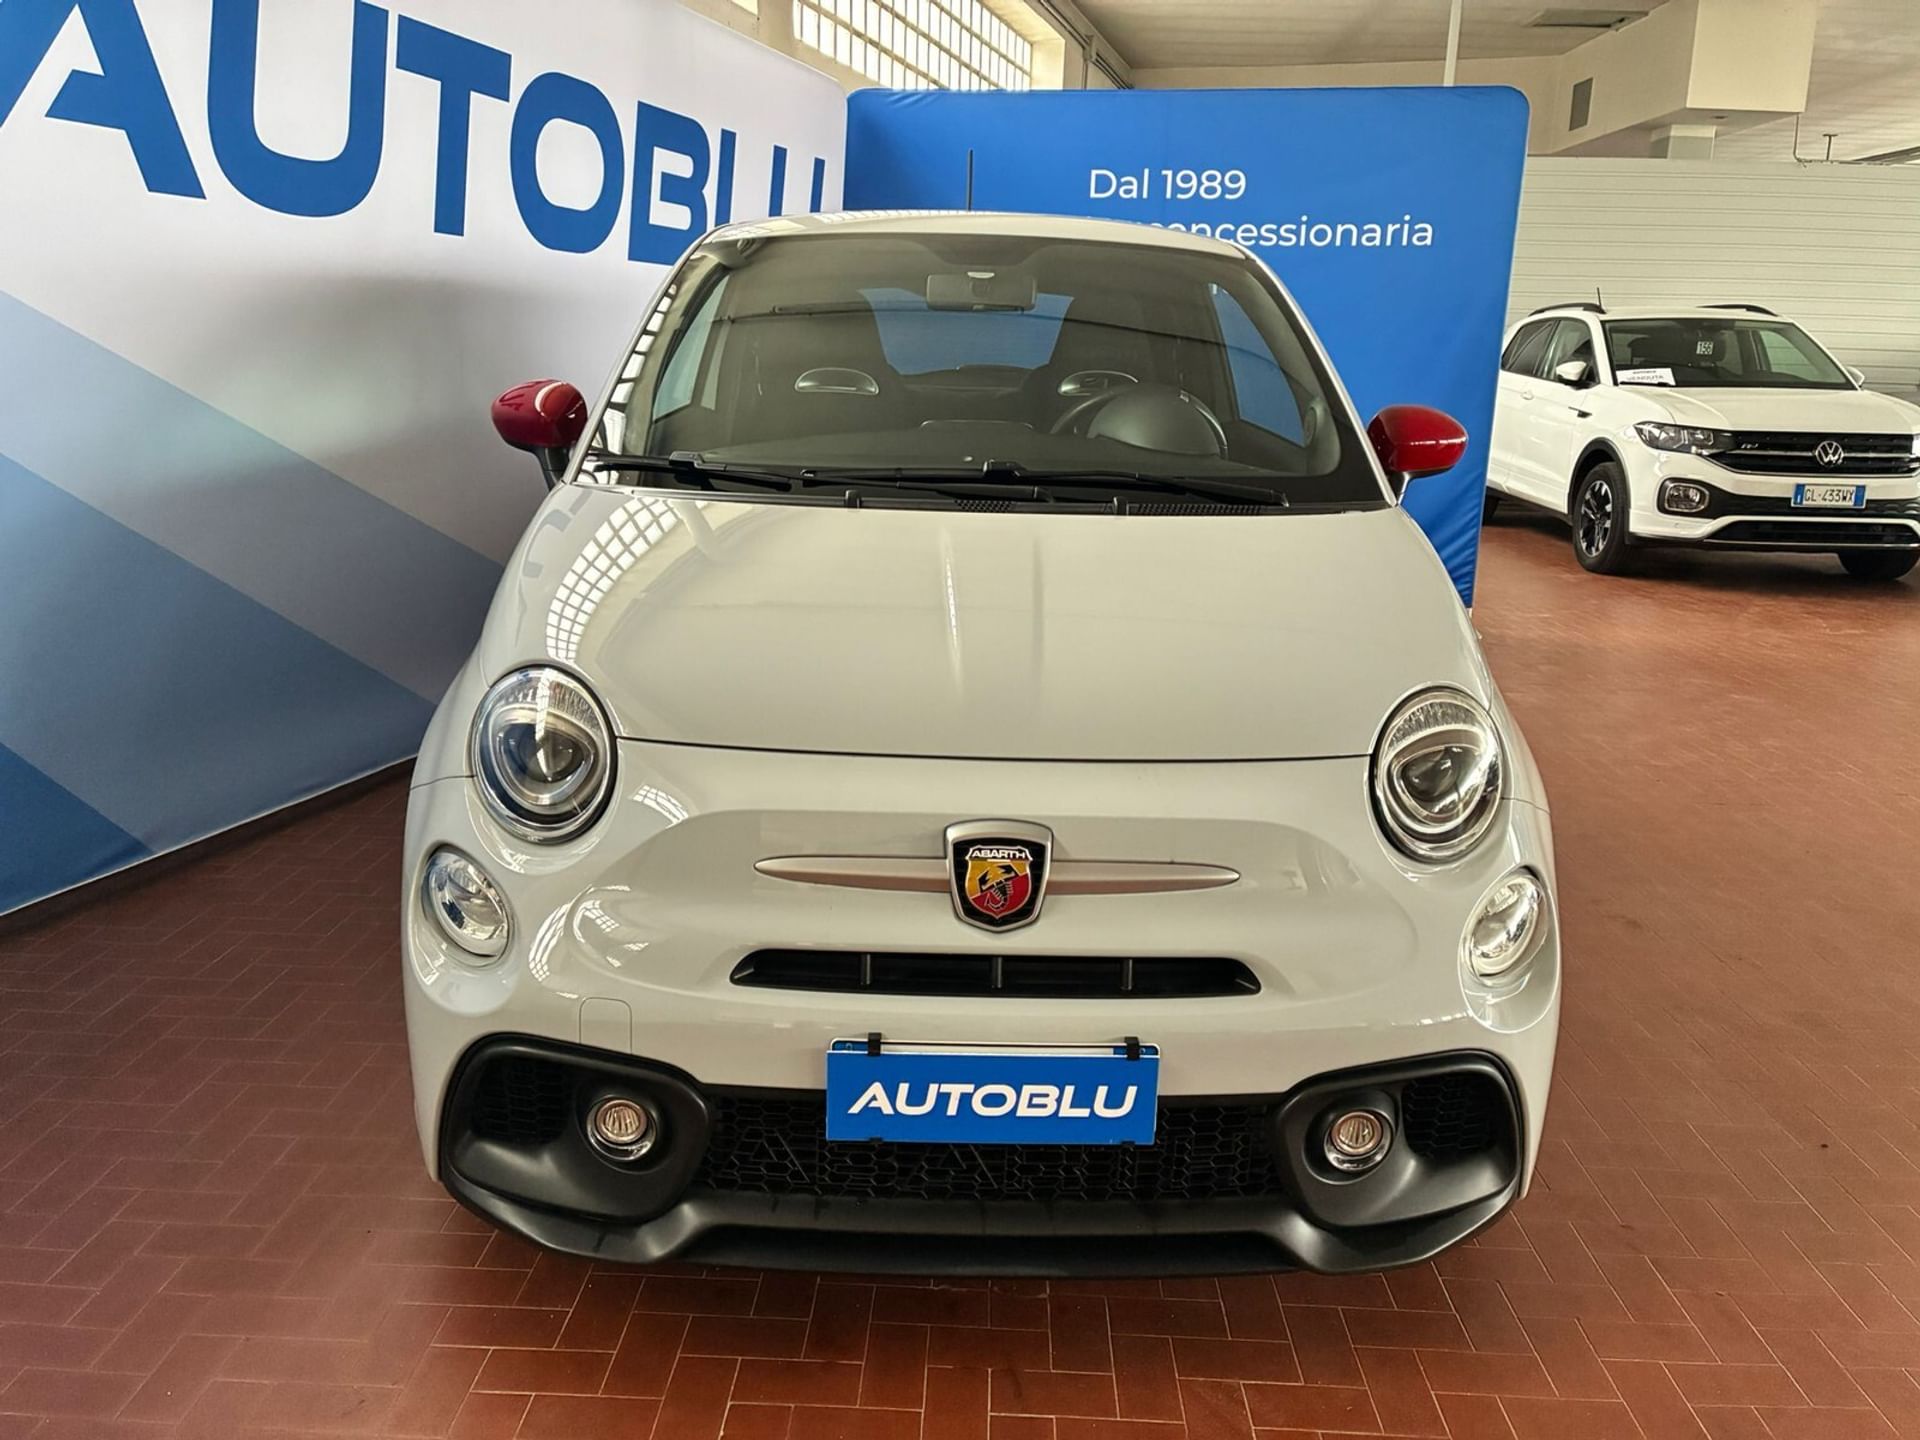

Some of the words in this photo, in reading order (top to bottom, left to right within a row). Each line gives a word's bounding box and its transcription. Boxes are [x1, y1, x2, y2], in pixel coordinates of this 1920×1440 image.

[1089, 168, 1150, 199] Dal
[1160, 169, 1247, 200] 1989
[1151, 214, 1434, 247] ncessionaria
[971, 849, 1026, 859] ABARTH
[847, 1081, 1138, 1118] AUTOBLU
